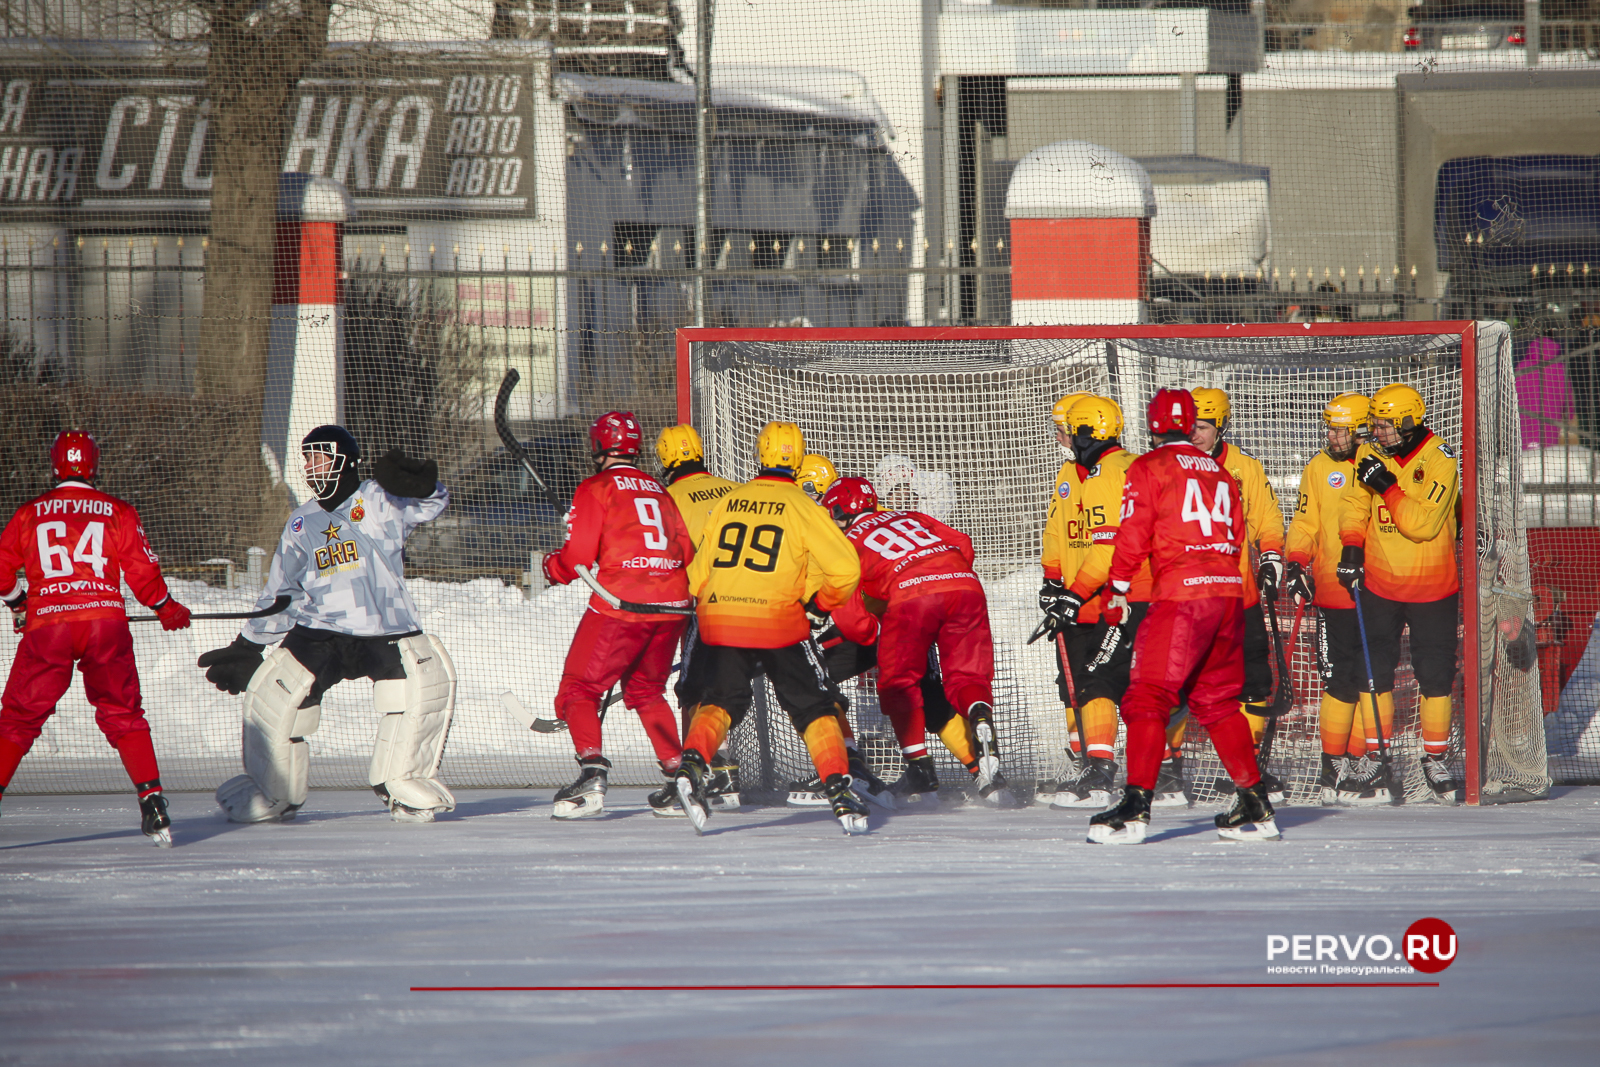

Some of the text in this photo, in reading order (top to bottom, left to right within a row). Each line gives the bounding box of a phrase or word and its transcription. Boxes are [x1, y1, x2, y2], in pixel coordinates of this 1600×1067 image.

[445, 74, 522, 113] АВТО
[96, 93, 433, 190] СТНКА
[445, 115, 522, 154] АВТО
[445, 156, 523, 196] АВТО
[626, 419, 635, 429] 9
[682, 439, 689, 447] 6
[781, 443, 793, 454] 99
[67, 449, 82, 463] 64
[1176, 453, 1220, 473] ОРЛОВ
[613, 475, 663, 494] БАГАЕВ
[859, 484, 873, 495] 88
[1427, 480, 1447, 503] 11
[34, 499, 113, 517] ТУРГУНОВ
[726, 499, 786, 516] МЯАТТЯ
[1085, 505, 1106, 527] 15
[1181, 478, 1235, 541] 44
[633, 497, 669, 551] 9
[36, 521, 108, 579] 64
[713, 521, 784, 573] 99
[864, 518, 943, 560] 88
[315, 540, 359, 570] СКА
[36, 601, 100, 616] СВЕРДЛОВСКАЯ
[719, 595, 768, 605] ПОЛИМЕТАЛЛ
